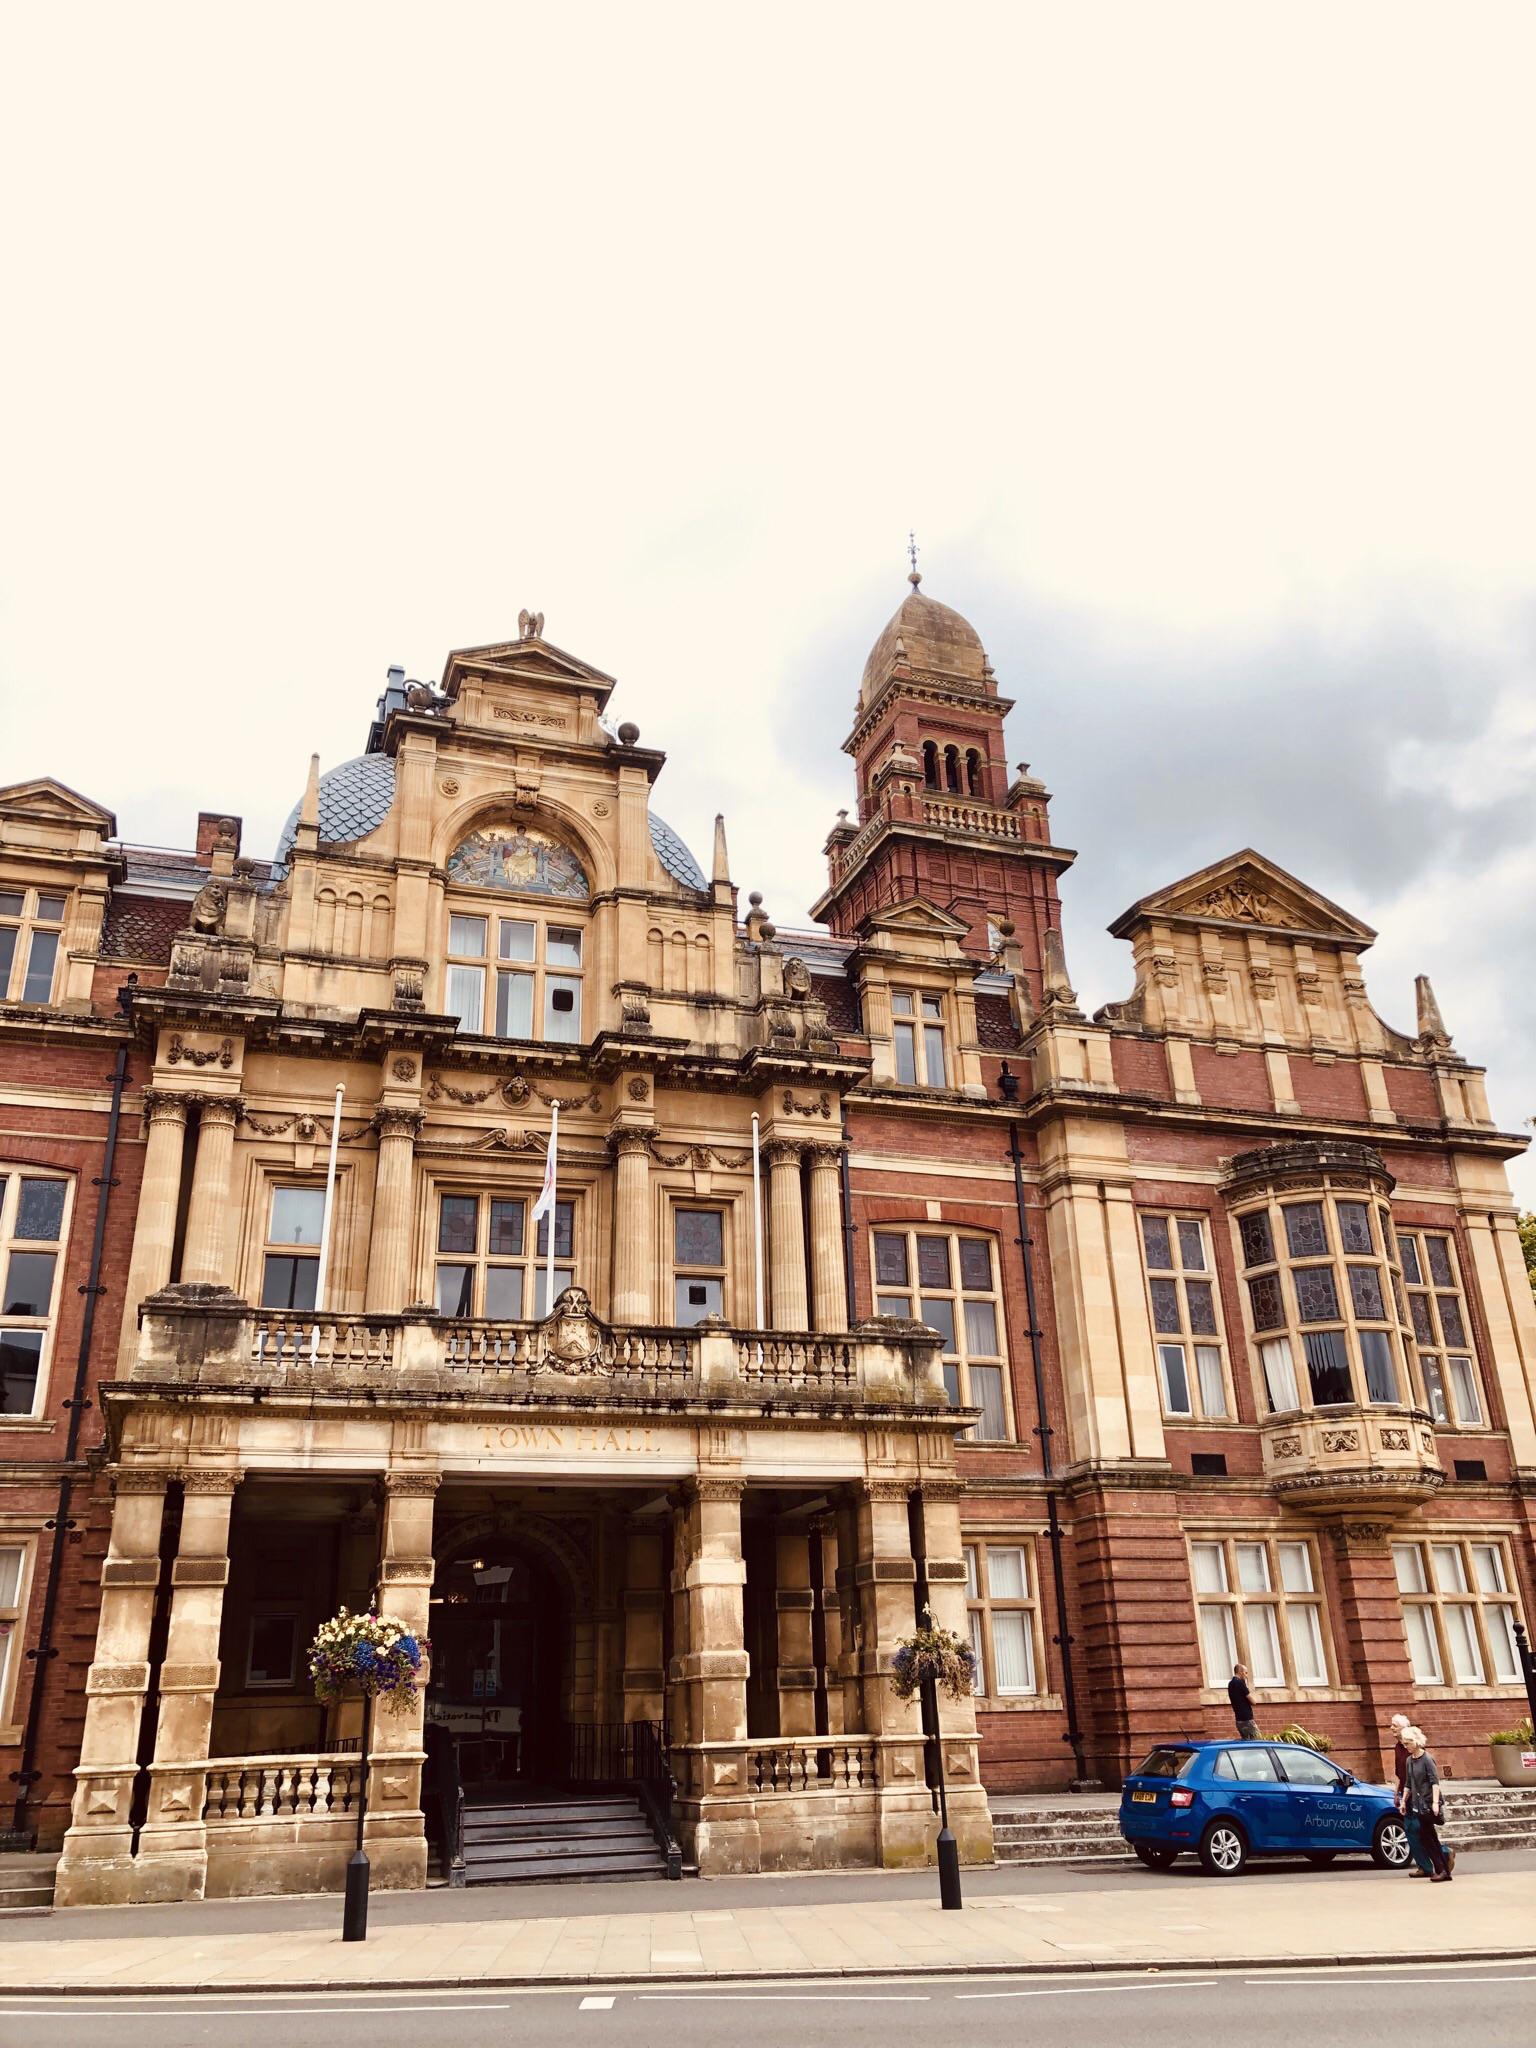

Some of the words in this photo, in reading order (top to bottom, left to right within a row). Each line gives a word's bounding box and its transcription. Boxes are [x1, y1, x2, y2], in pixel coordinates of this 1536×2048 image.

[478, 1426, 563, 1450] TOWN
[577, 1428, 661, 1452] HALL
[1317, 1800, 1348, 1813] Courtesy
[1349, 1802, 1363, 1812] Car
[1304, 1814, 1365, 1831] Arbury.co.uk
